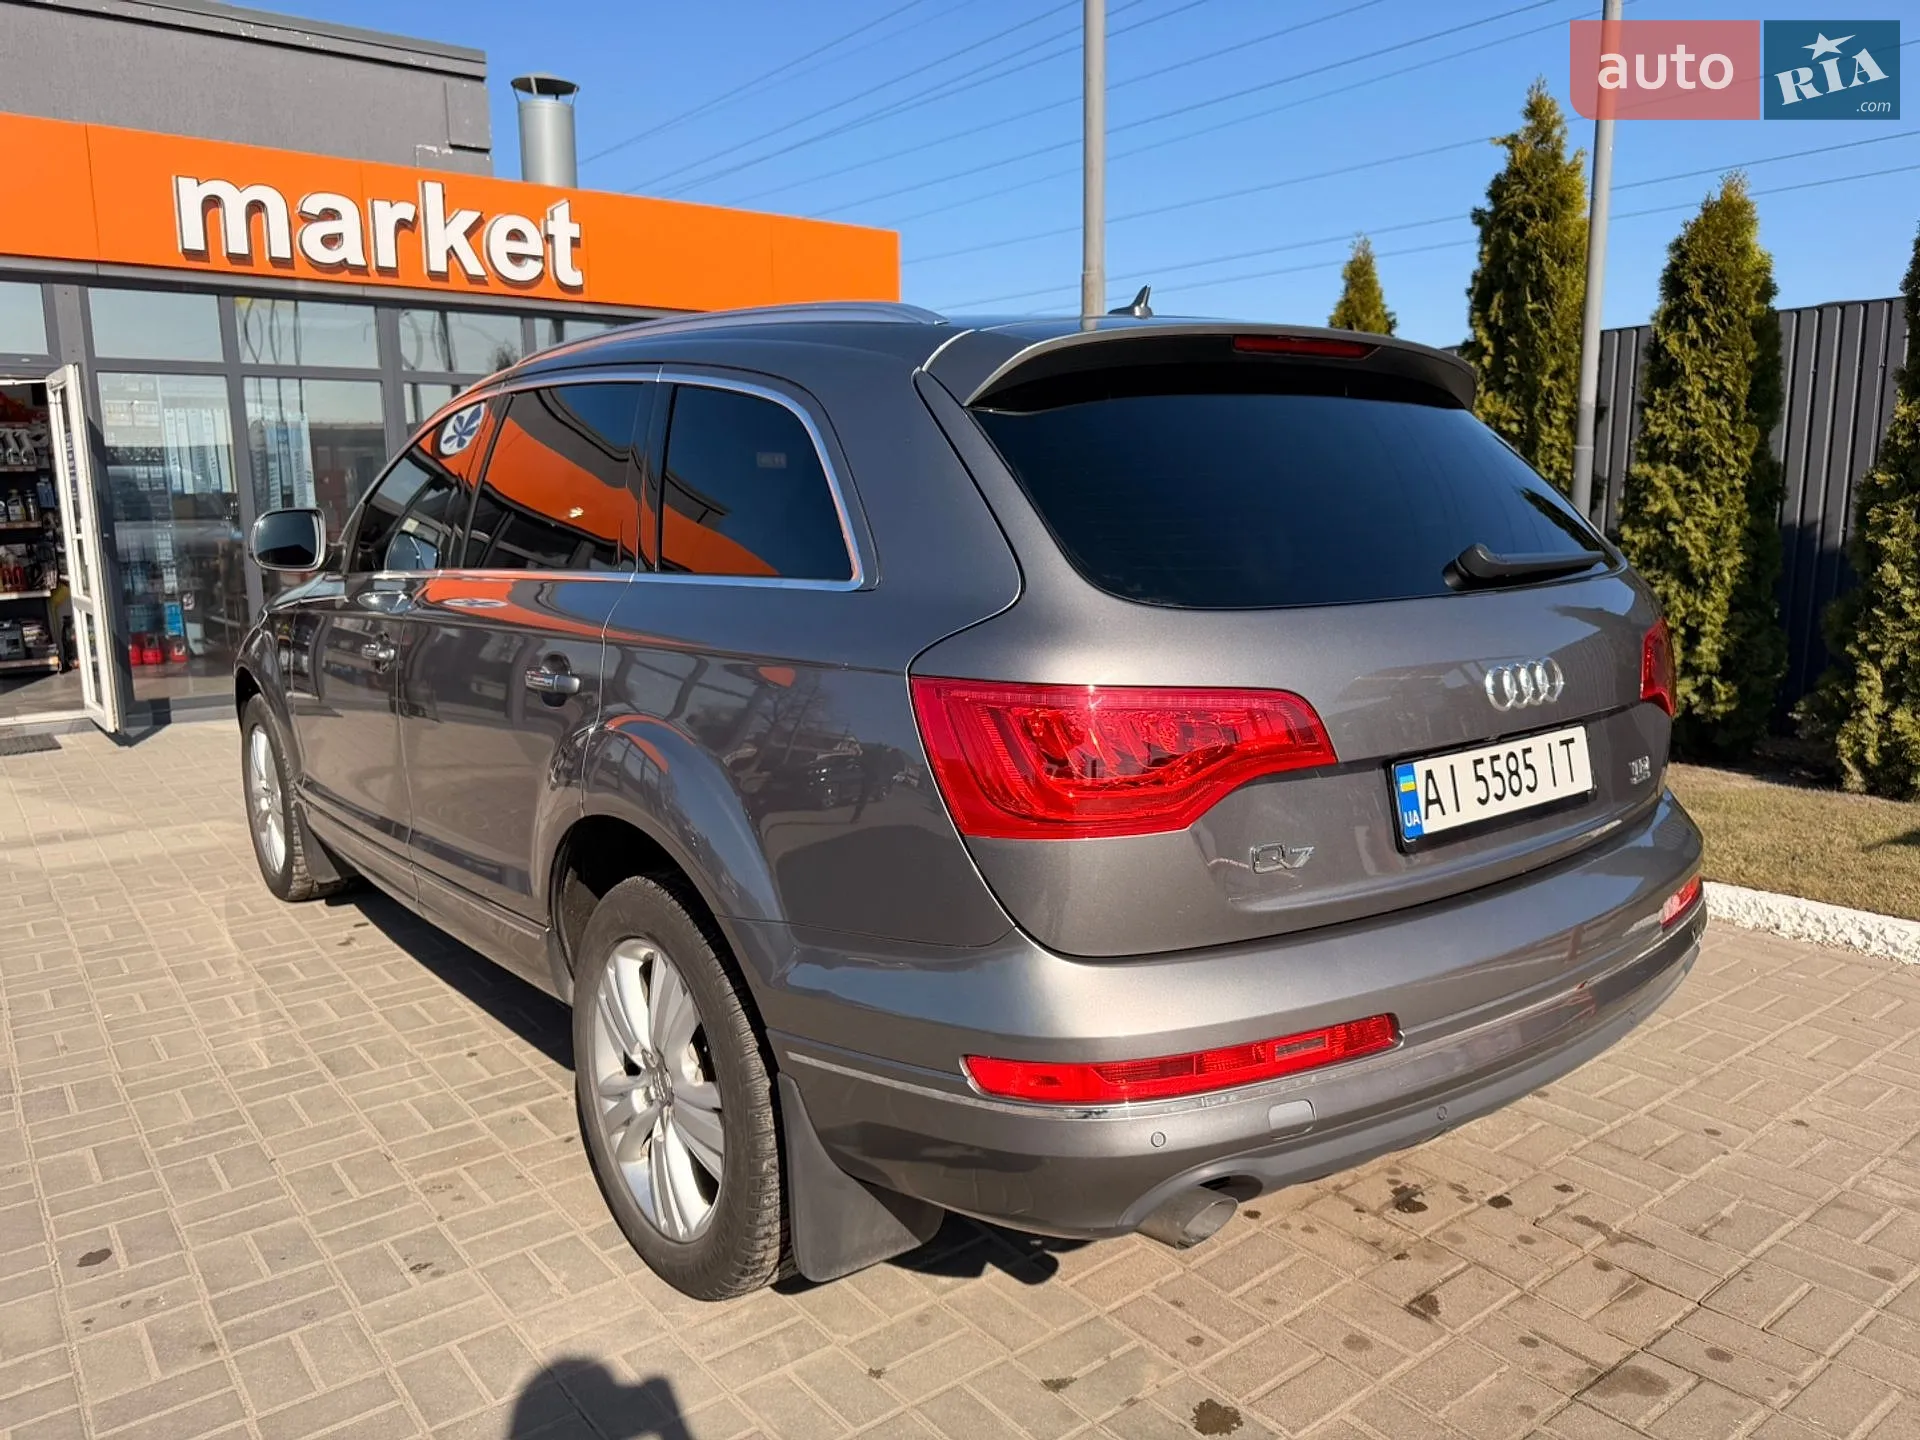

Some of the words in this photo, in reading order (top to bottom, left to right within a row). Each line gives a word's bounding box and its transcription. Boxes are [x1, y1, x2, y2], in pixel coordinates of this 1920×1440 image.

[173, 175, 583, 290] market
[1424, 764, 1460, 820] AI
[1472, 747, 1538, 805] 5585
[1547, 738, 1575, 787] IT
[1404, 811, 1421, 828] UA
[1249, 841, 1315, 874] Q7
